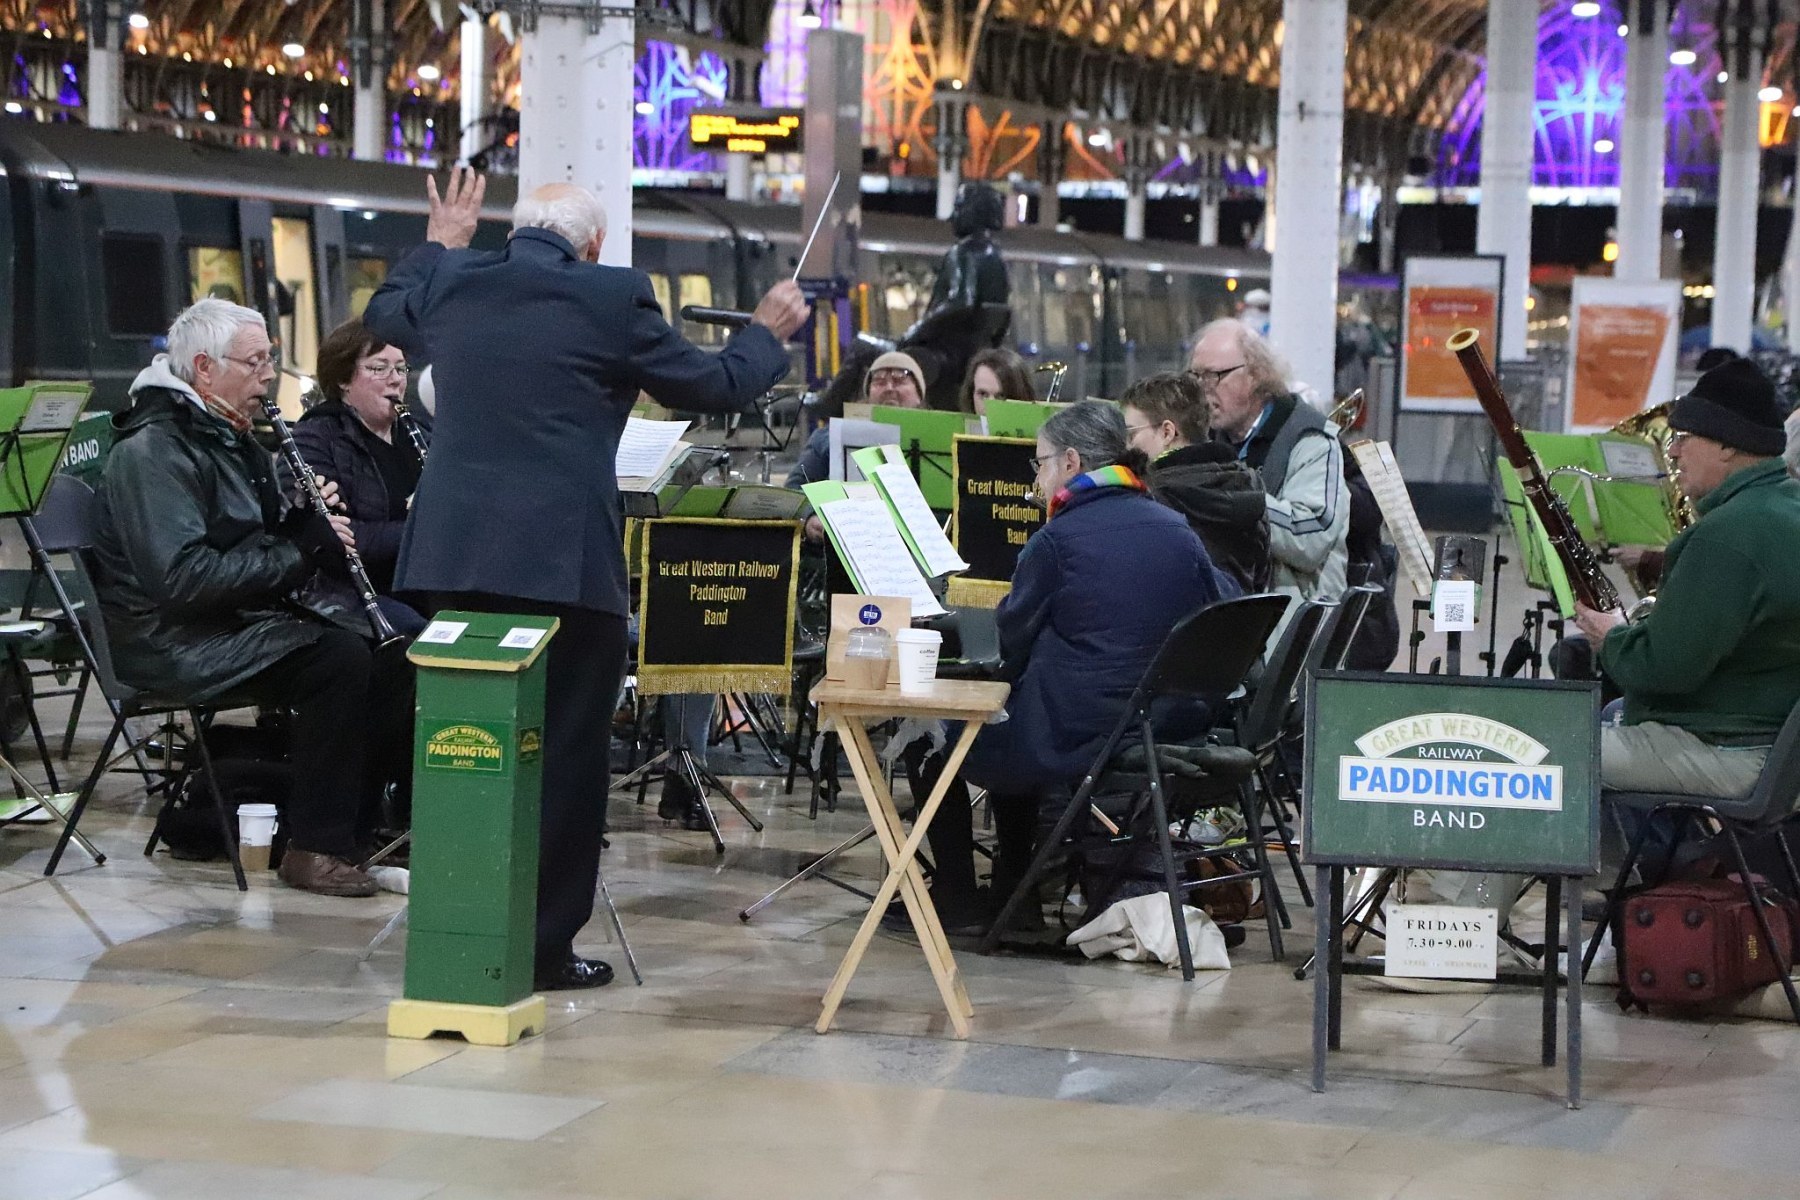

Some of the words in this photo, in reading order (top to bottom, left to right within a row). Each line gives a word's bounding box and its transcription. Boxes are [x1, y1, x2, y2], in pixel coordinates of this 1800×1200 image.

[69, 439, 99, 465] BAND
[967, 479, 992, 496] Great
[994, 480, 1031, 497] Western
[992, 503, 1040, 523] Paddington
[1007, 527, 1028, 545] Band
[659, 560, 688, 576] Great
[691, 560, 736, 577] Western
[738, 561, 780, 579] Railway
[690, 584, 747, 602] Paddington
[704, 608, 728, 625] Band
[436, 728, 459, 741] GREAT
[460, 727, 494, 745] WESTERN
[1371, 718, 1433, 753] GREAT
[1440, 717, 1532, 757] WESTERN
[428, 743, 500, 759] PADDINGTON
[1418, 746, 1483, 761] RAILWAY
[453, 759, 475, 767] BAND
[1350, 765, 1552, 801] PADDINGTON
[1413, 809, 1485, 830] BAND
[1407, 919, 1482, 932] FRIDAYS
